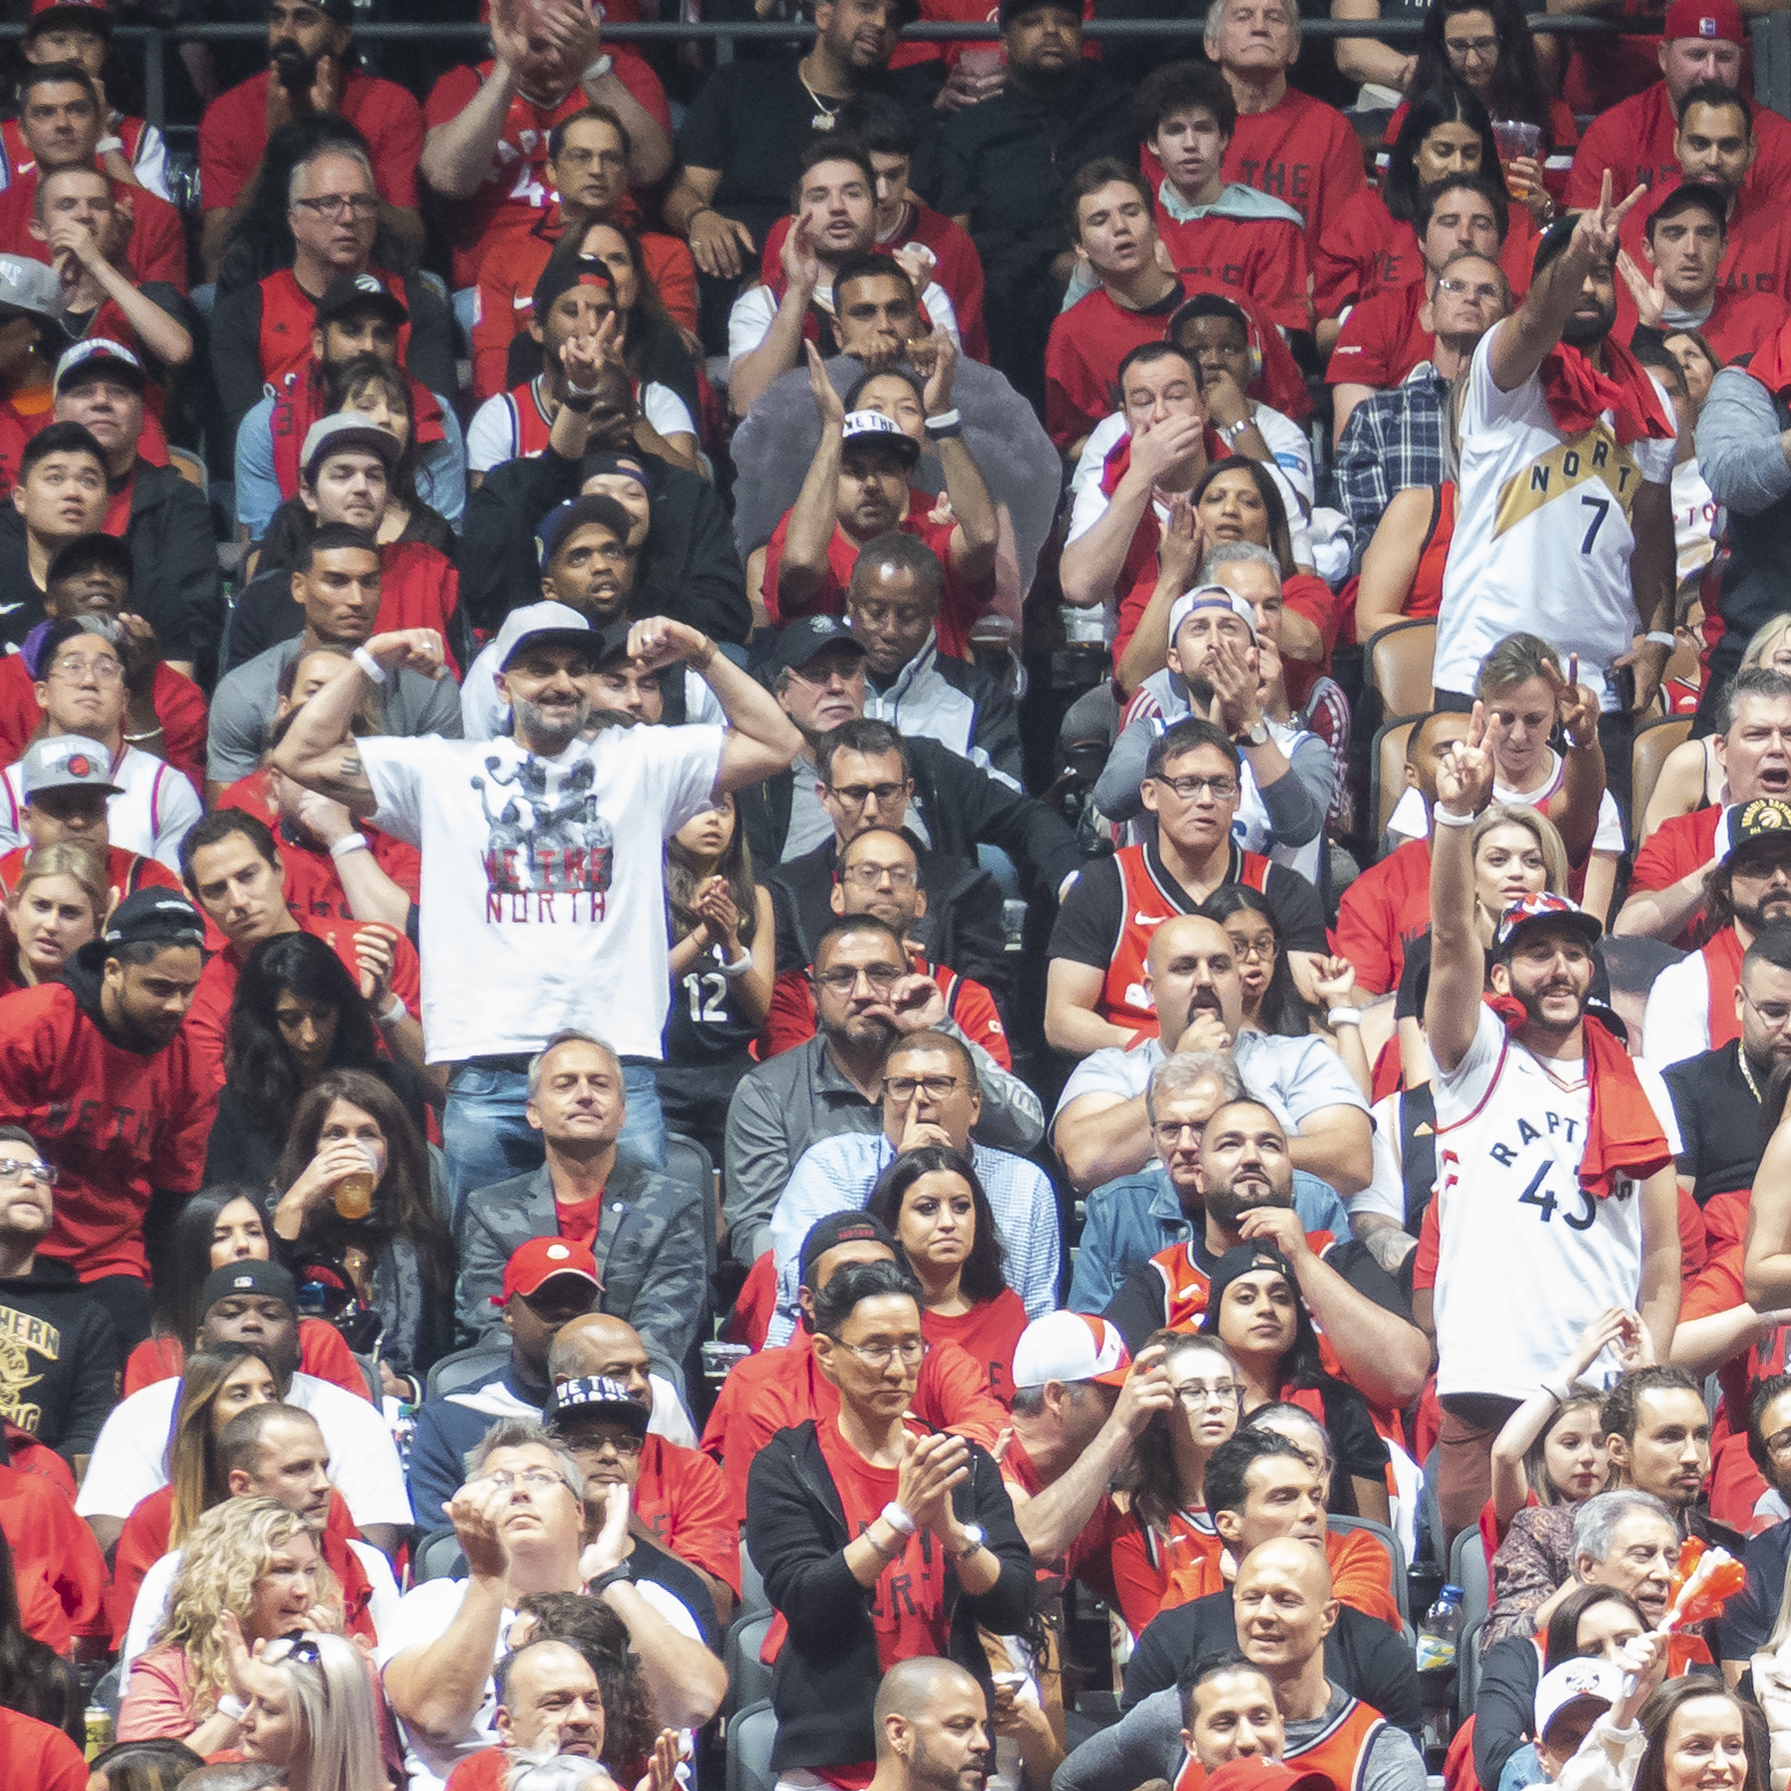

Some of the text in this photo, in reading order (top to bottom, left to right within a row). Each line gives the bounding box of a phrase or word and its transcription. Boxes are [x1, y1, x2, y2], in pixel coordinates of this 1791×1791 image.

[1580, 495, 1610, 554] 7
[536, 848, 608, 884] THE
[486, 891, 606, 924] NORTH
[683, 972, 728, 1022] 12
[1489, 1109, 1632, 1202] RAPTS
[556, 1380, 580, 1399] WE
[587, 1376, 626, 1393] THE
